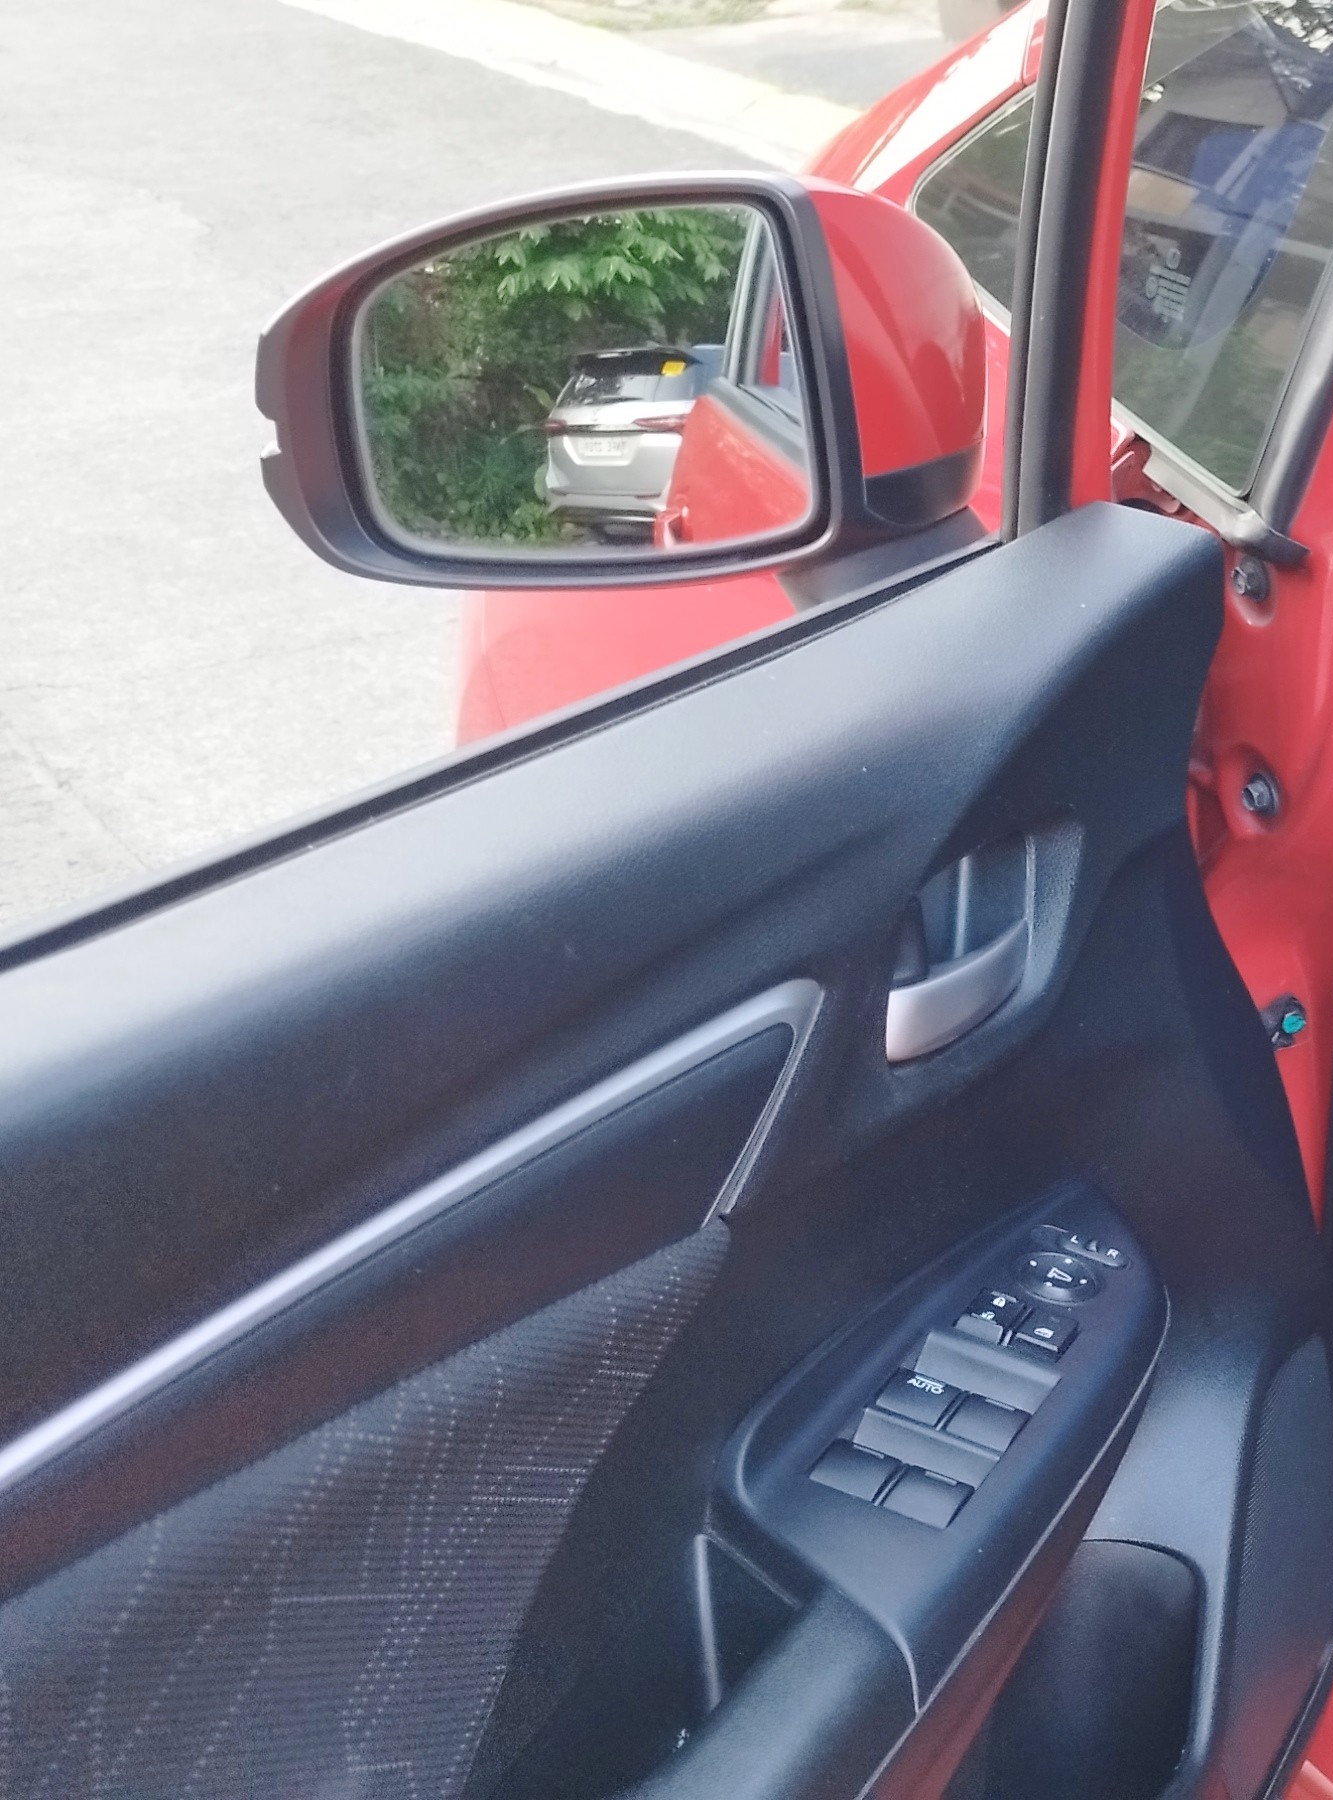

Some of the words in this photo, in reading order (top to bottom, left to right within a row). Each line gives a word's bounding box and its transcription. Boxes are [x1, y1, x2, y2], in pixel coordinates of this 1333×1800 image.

[1070, 1234, 1079, 1244] L
[1106, 1248, 1119, 1260] R
[906, 1378, 944, 1395] AUTO
